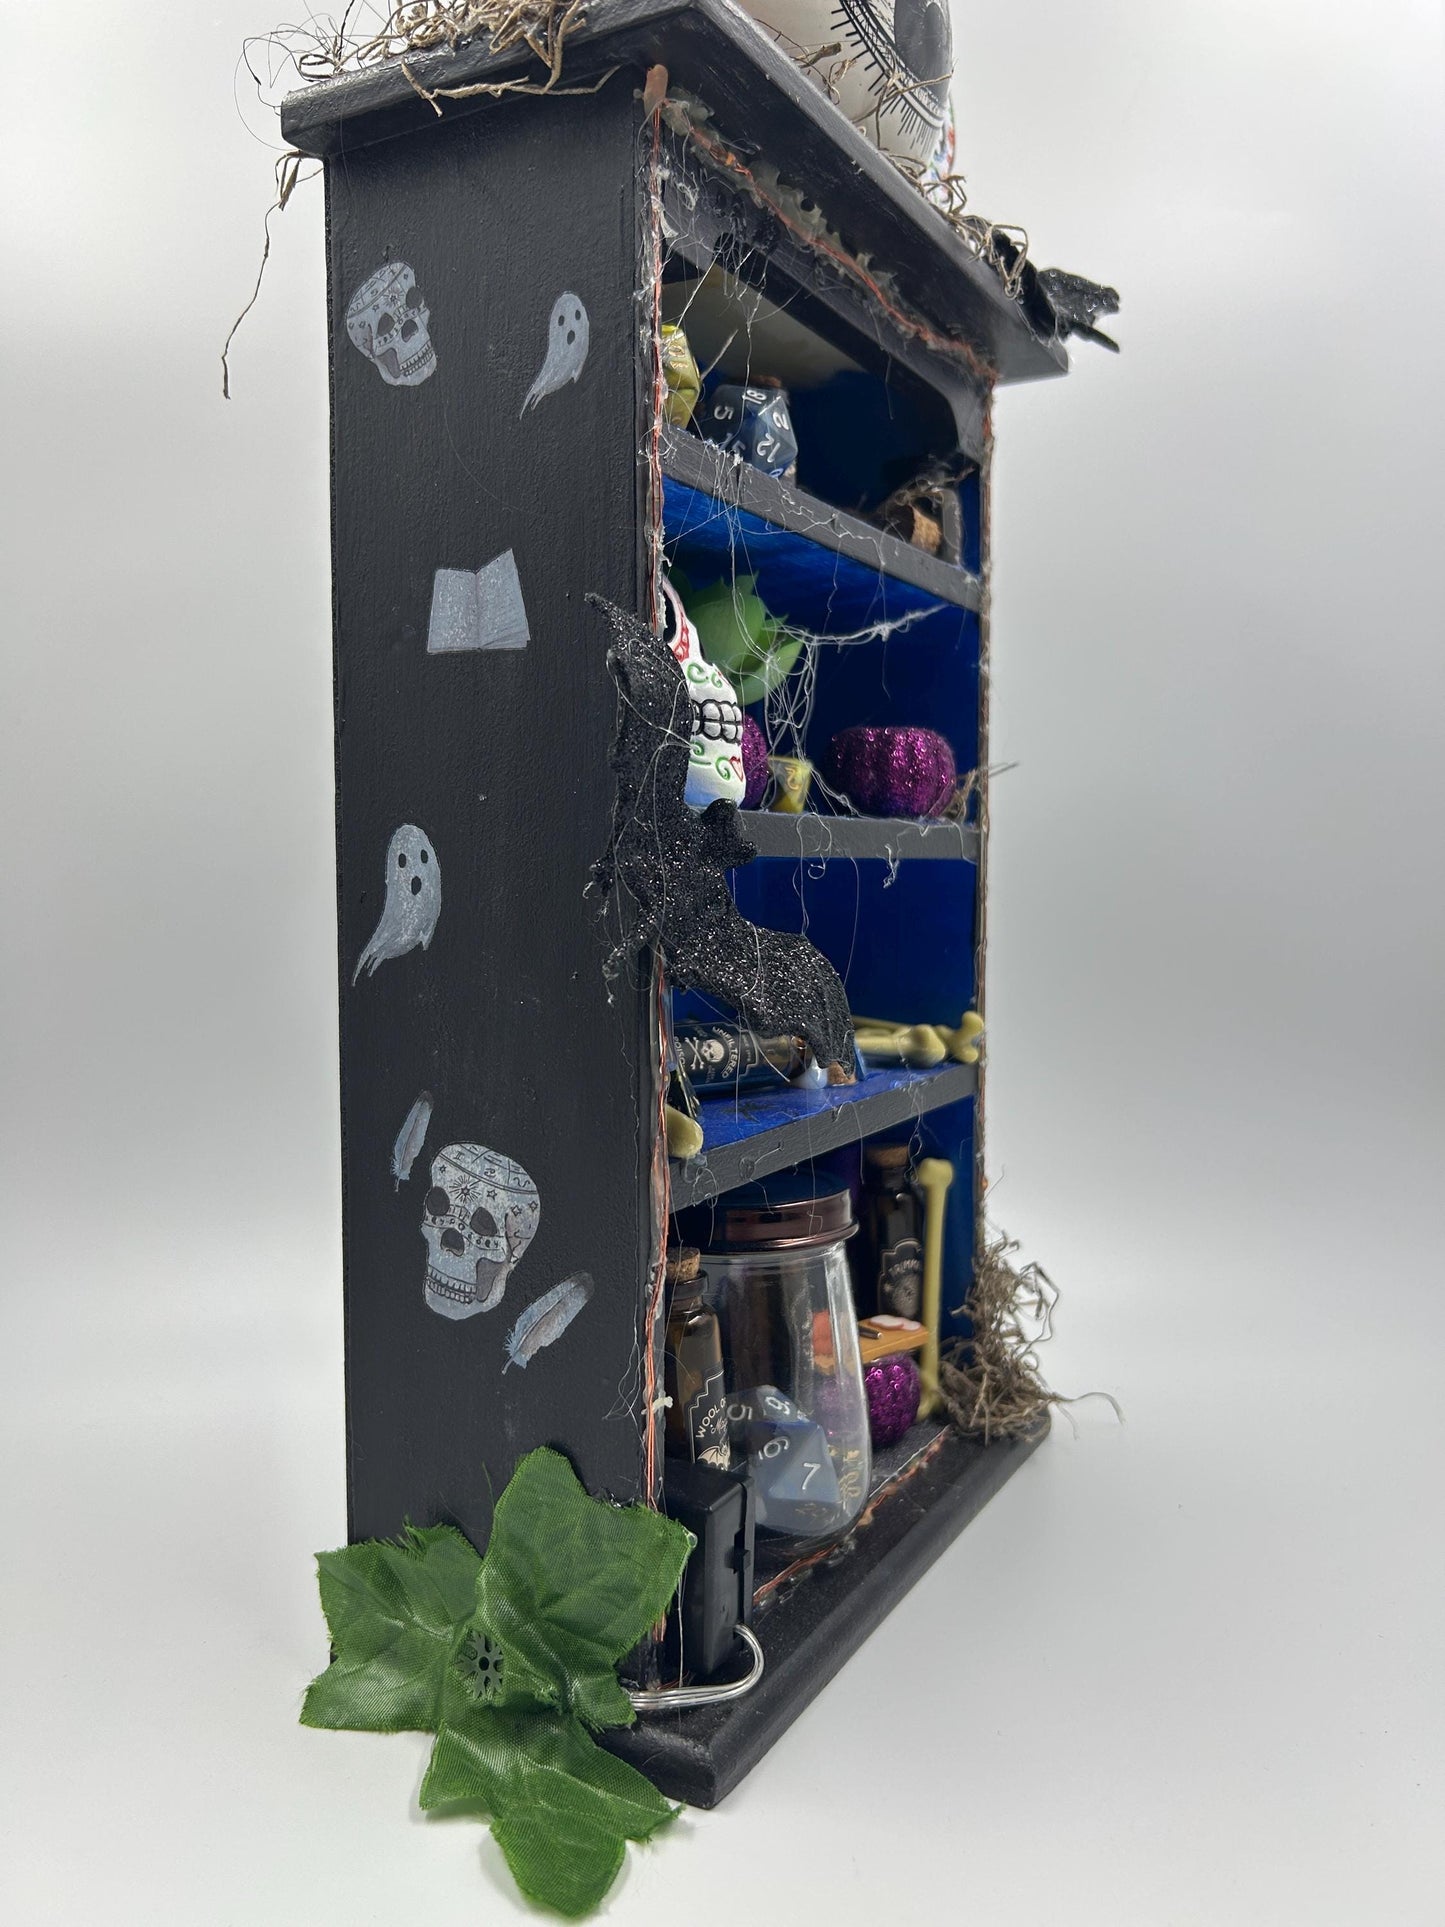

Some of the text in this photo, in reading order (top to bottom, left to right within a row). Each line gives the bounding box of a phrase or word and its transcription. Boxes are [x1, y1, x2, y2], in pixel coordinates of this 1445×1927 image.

[742, 389, 767, 405] 18
[713, 405, 735, 420] 5
[756, 432, 781, 463] 12
[674, 1036, 687, 1068] POISO
[695, 1404, 720, 1438] WOOL
[803, 1462, 821, 1491] 7
